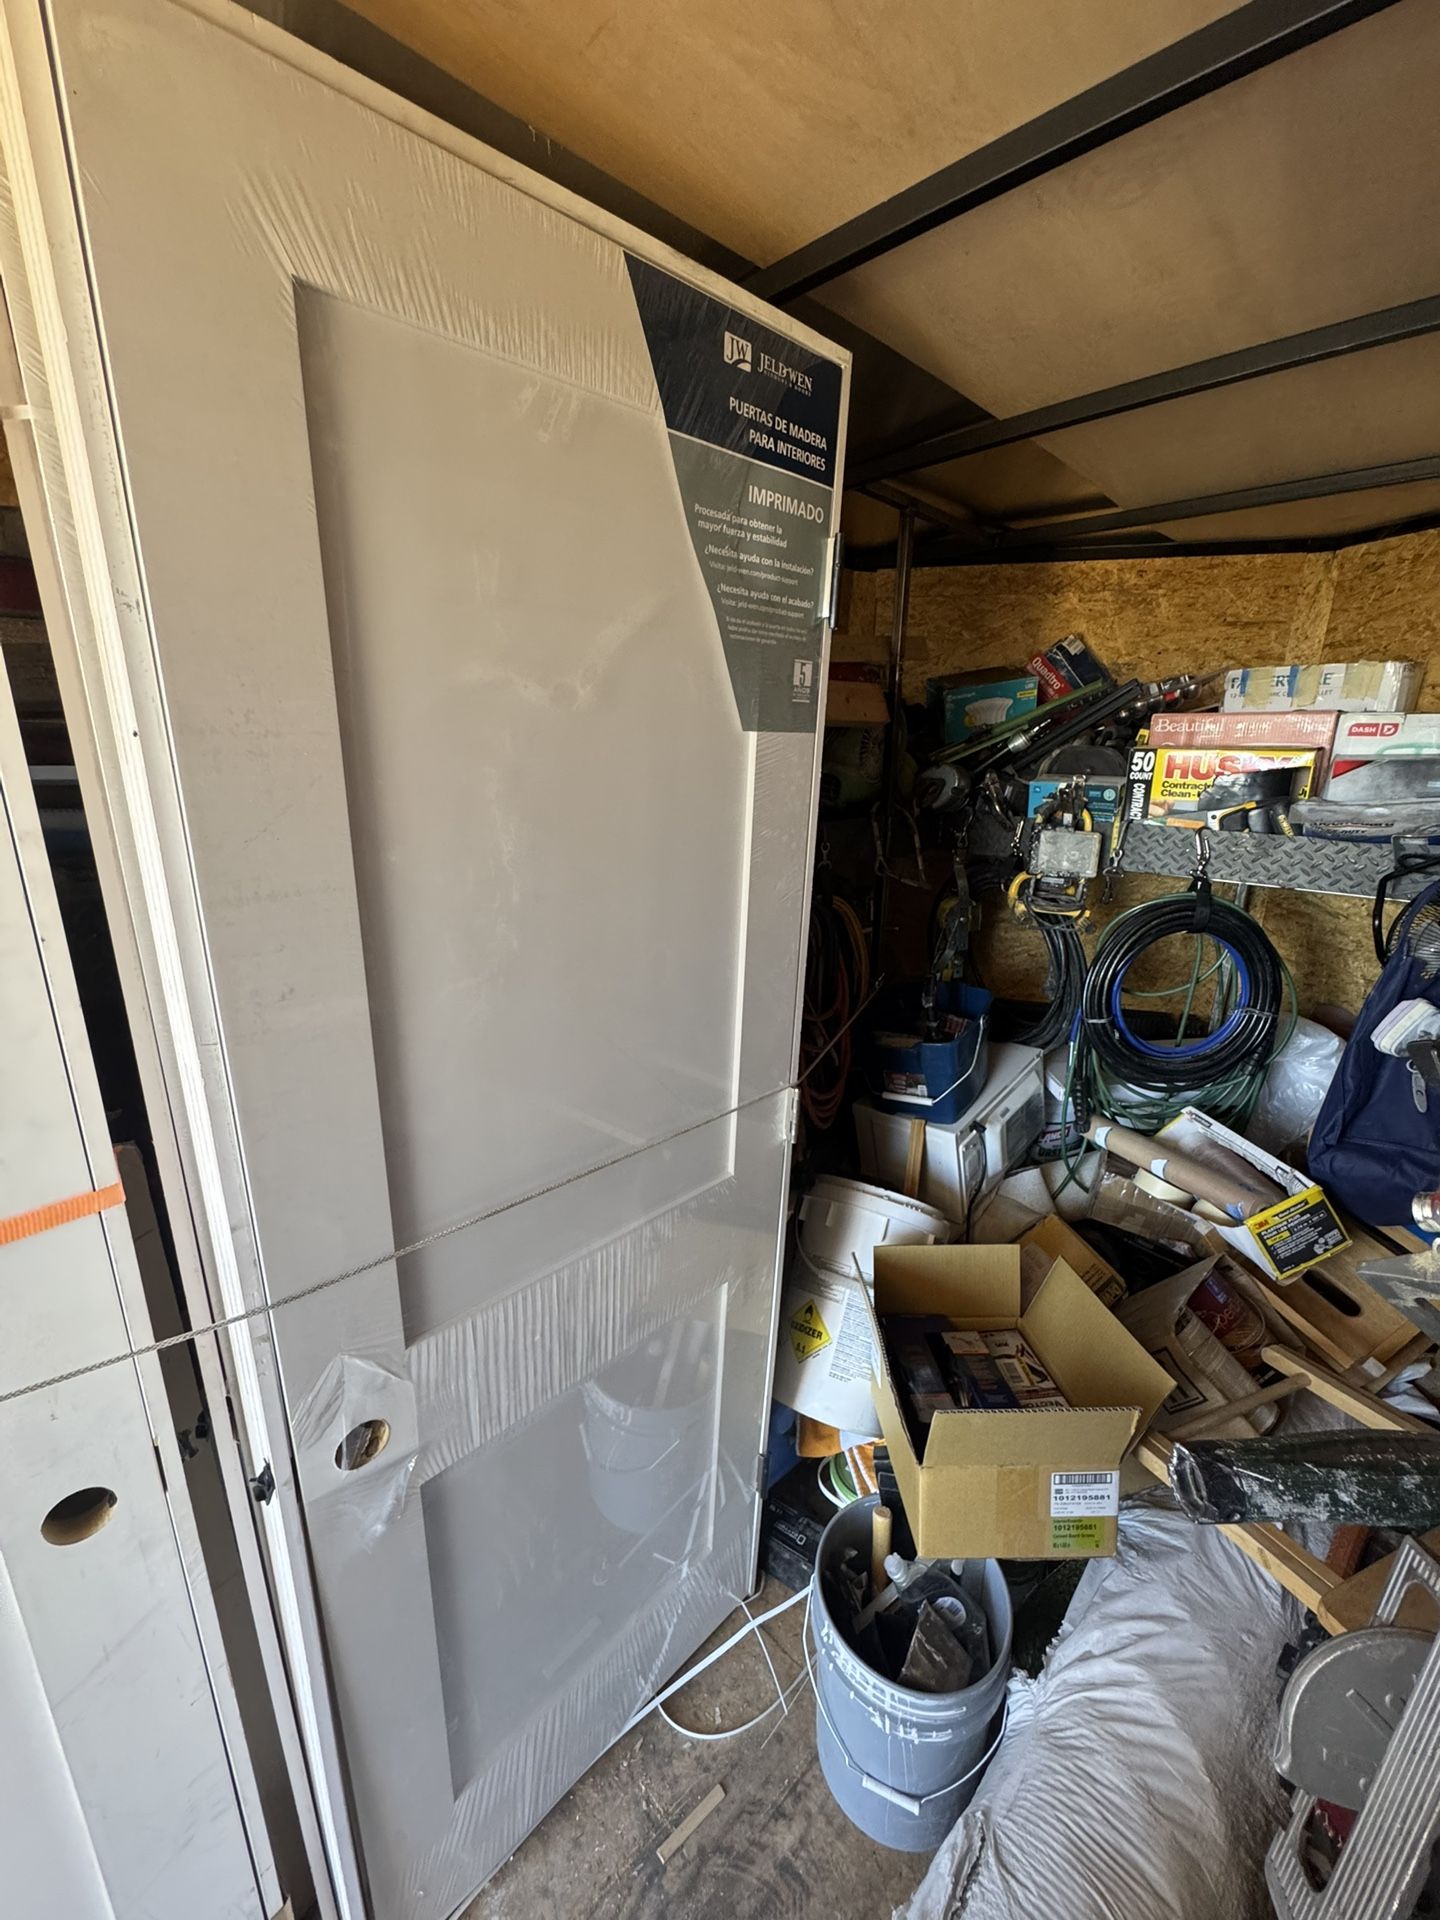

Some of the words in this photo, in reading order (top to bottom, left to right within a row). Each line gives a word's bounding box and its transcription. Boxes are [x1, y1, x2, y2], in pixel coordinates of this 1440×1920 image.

[729, 396, 773, 428] PUERTAS
[774, 416, 788, 434] DE
[789, 422, 828, 451] MADERA
[749, 428, 775, 452] PARA
[776, 439, 826, 472] INTERIORES
[748, 485, 824, 524] IMPRIMADO
[697, 519, 721, 533] mayor
[722, 524, 745, 538] fuerza
[746, 531, 751, 542] y
[752, 532, 787, 549] estabilidad
[731, 514, 748, 527] para
[749, 518, 775, 533] obtener
[776, 524, 783, 535] la
[739, 551, 760, 565] ayuda
[761, 557, 773, 567] con
[774, 557, 780, 568] la
[750, 589, 770, 601] ayuda
[770, 594, 781, 602] con
[782, 594, 788, 605] el
[1131, 751, 1156, 772] 50
[1129, 771, 1154, 781] COUNT
[1254, 1219, 1270, 1230] 3M
[1053, 1494, 1111, 1502] 1012195881
